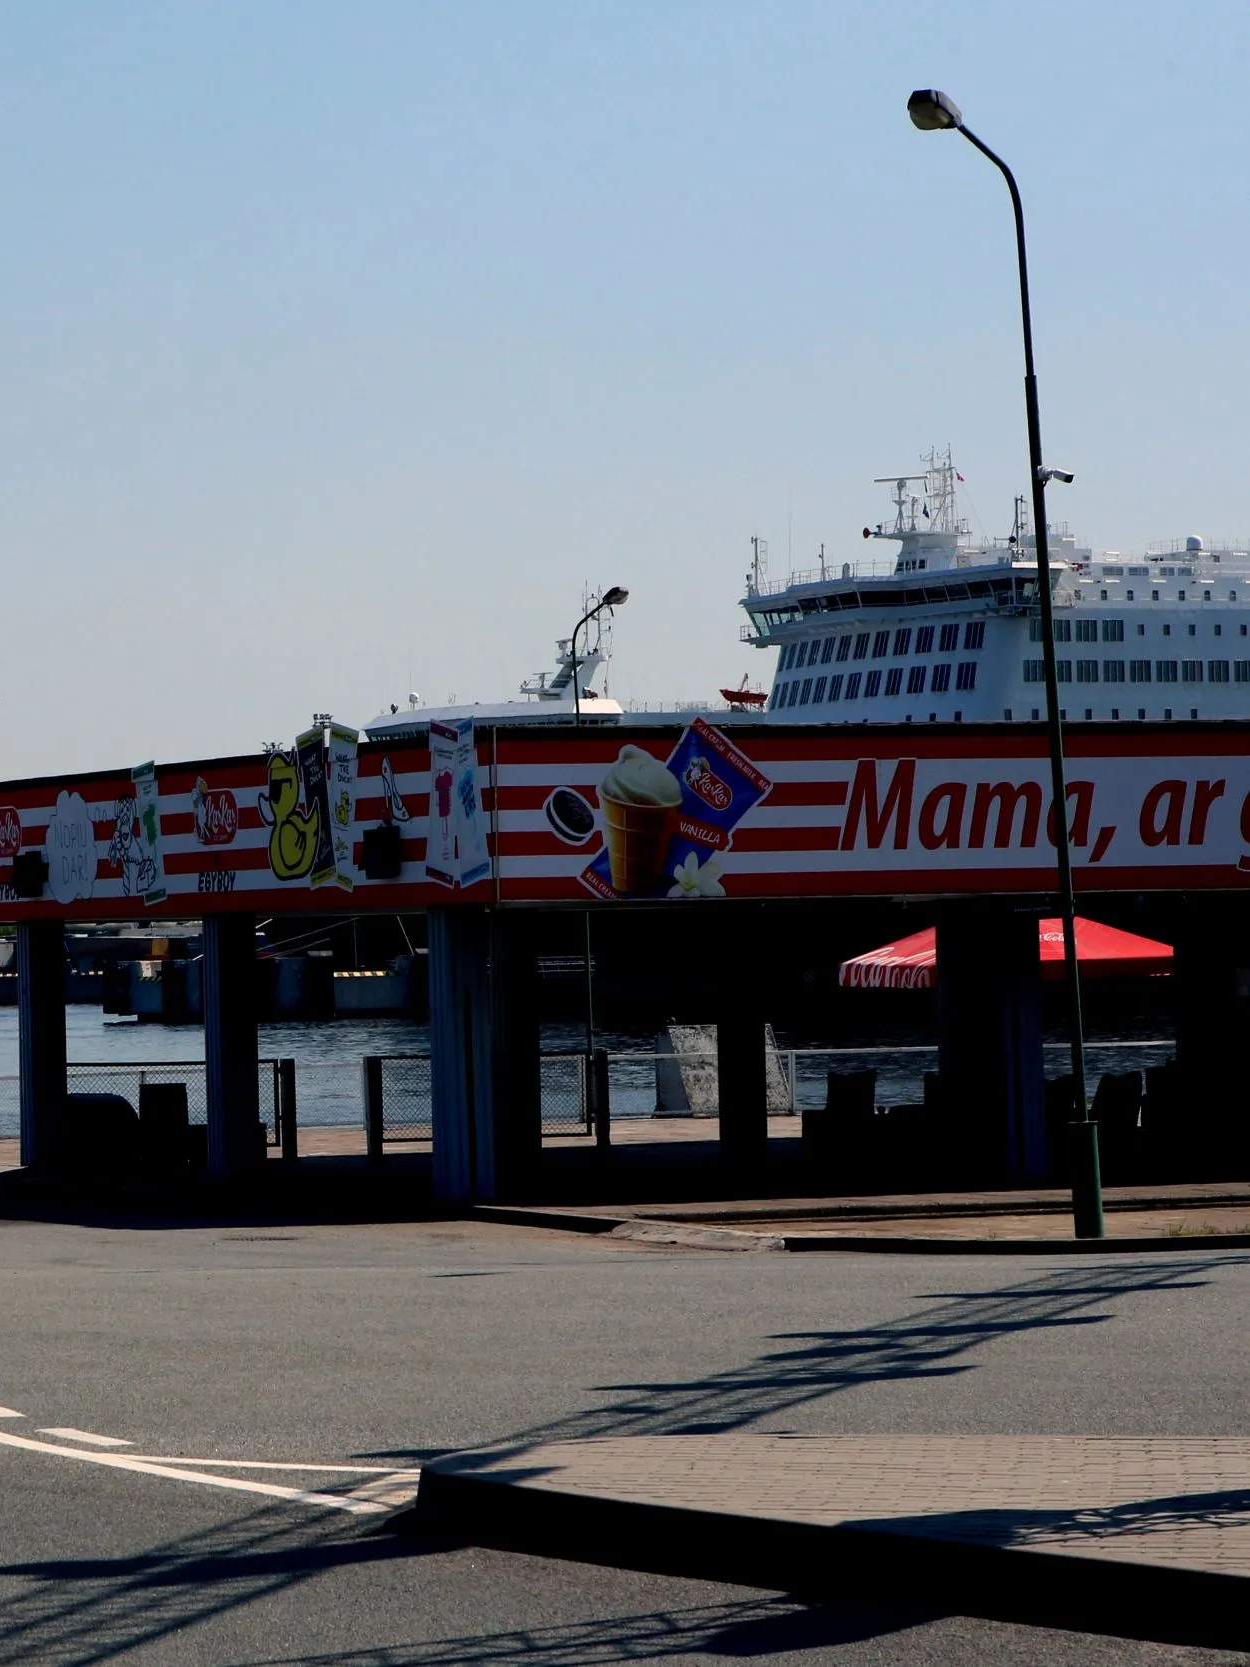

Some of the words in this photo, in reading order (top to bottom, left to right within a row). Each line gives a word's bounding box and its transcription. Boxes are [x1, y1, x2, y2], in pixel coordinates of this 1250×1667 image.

[679, 820, 721, 844] VANILLA
[840, 758, 1117, 864] Mama,
[1138, 778, 1227, 848] ar
